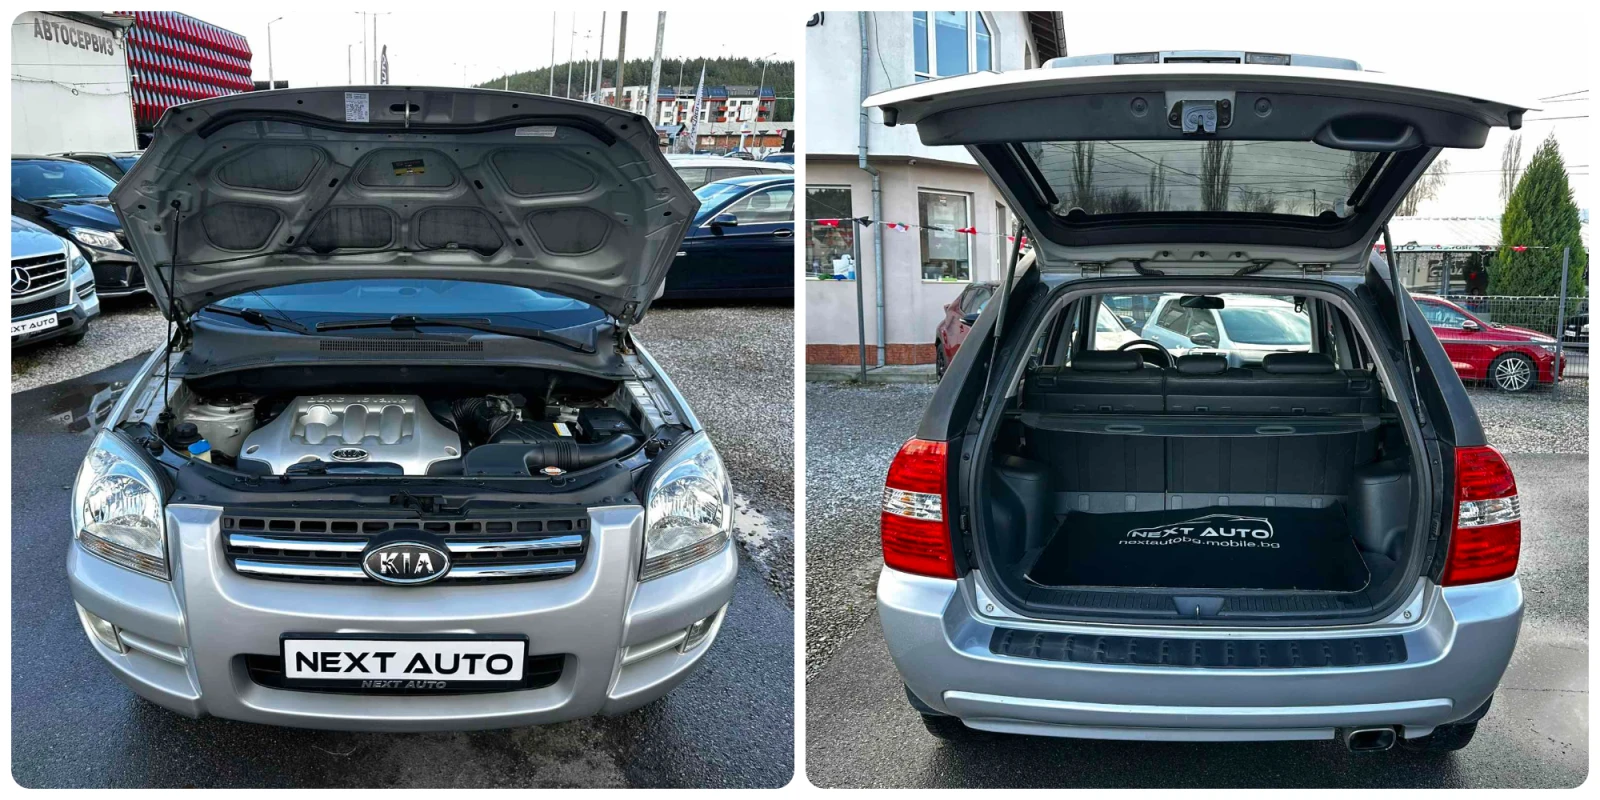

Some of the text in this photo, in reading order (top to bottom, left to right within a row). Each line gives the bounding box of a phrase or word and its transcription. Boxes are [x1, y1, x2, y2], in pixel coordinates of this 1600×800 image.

[34, 17, 114, 56] АВТОСЕРВИЗ
[29, 317, 55, 329] AUTO
[1131, 527, 1270, 539] NEXT AUTO
[1118, 536, 1281, 549] nextautobg.mobile.bg
[378, 552, 435, 574] KIA
[295, 651, 514, 675] NEXT AUTO
[361, 679, 447, 689] NEXT AUTO
